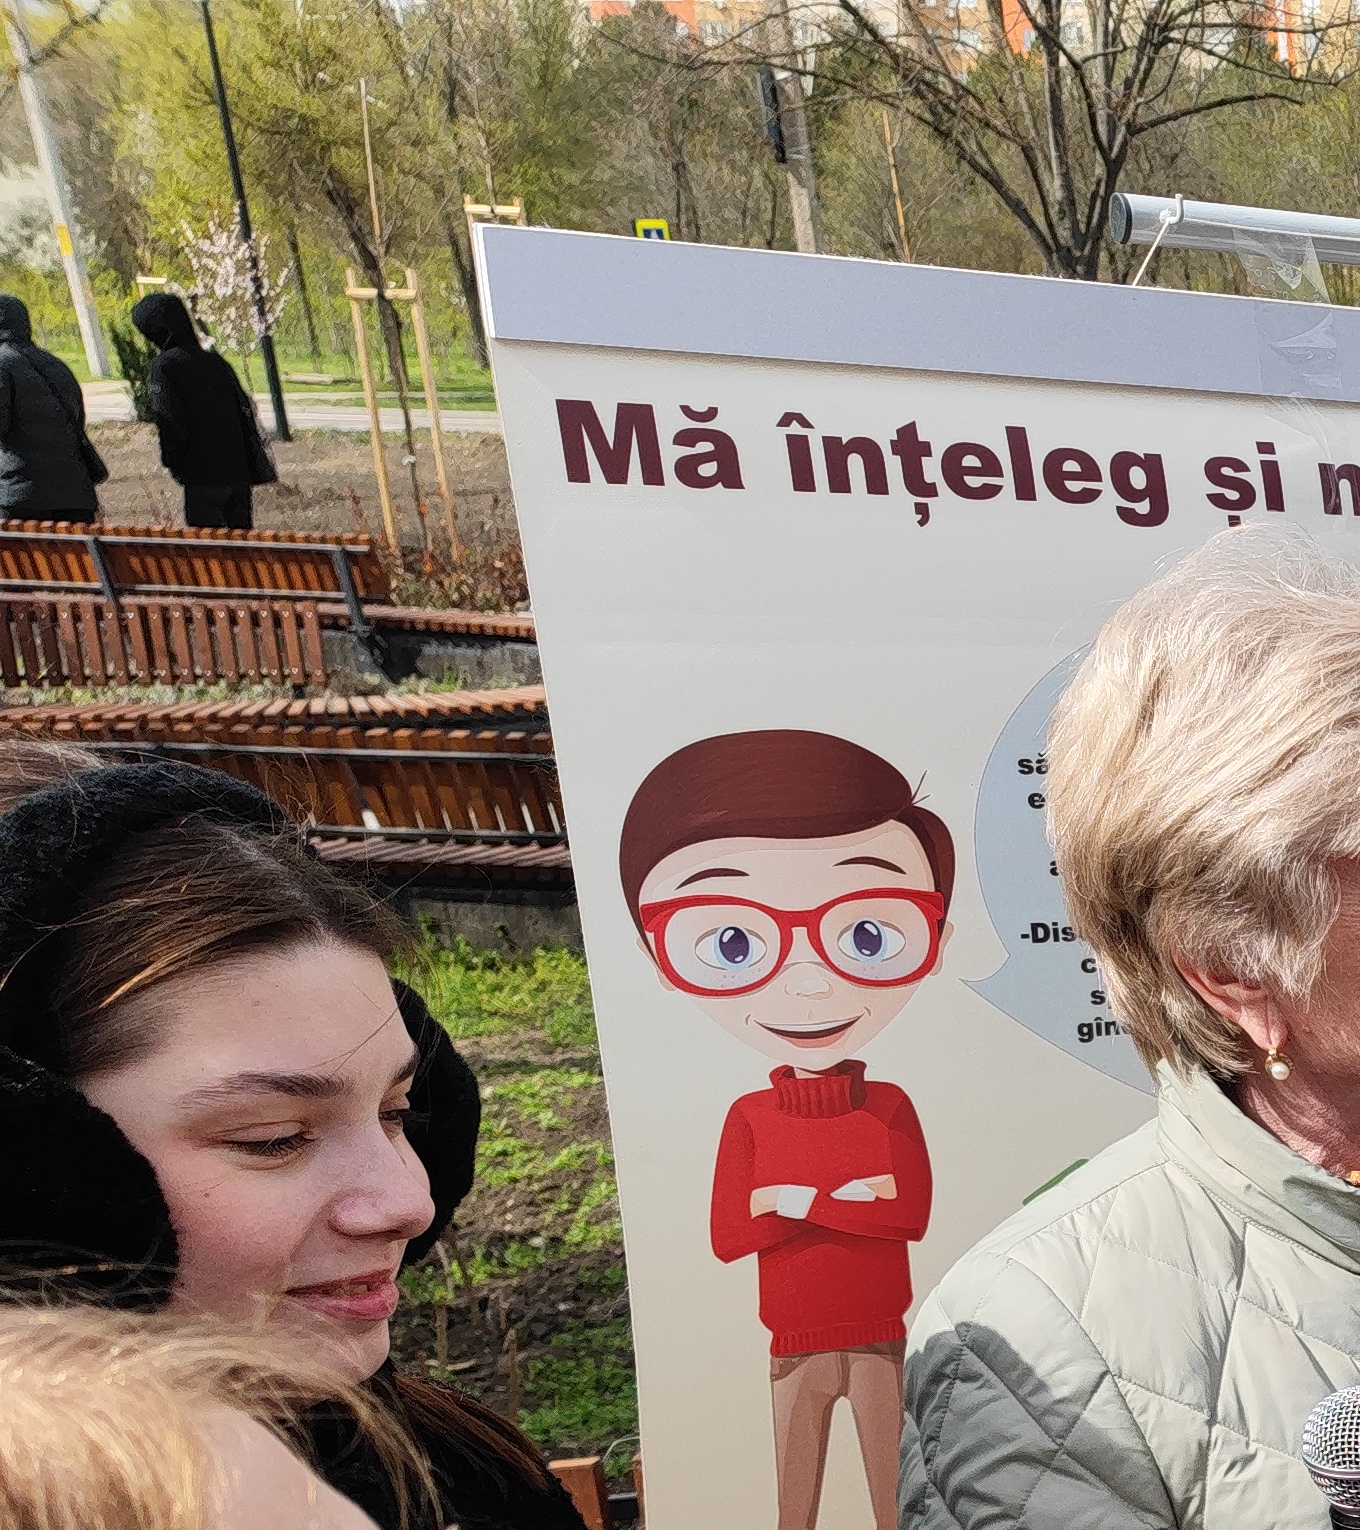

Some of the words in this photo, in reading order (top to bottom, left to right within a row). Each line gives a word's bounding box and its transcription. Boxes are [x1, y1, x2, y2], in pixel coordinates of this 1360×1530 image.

[555, 399, 744, 489] Mă
[777, 412, 1168, 527] înțeleg
[1205, 441, 1284, 527] și
